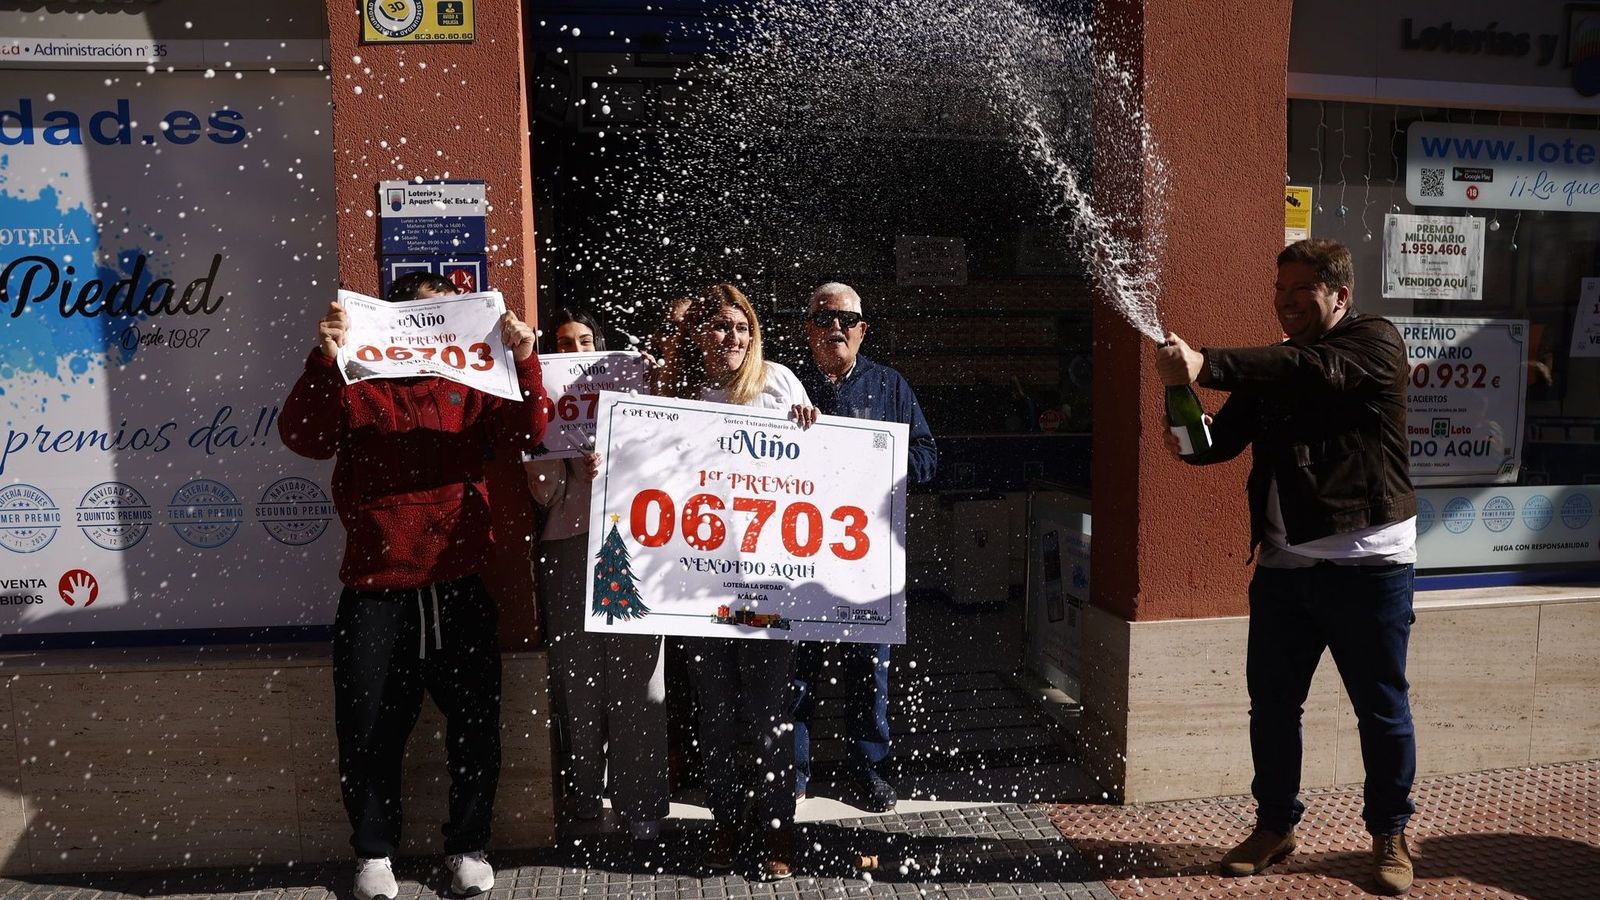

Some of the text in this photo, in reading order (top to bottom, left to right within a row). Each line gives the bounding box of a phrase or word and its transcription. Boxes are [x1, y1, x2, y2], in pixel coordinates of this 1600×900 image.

[388, 1, 405, 13] 3D
[33, 43, 134, 58] Administración
[153, 44, 168, 57] 35
[1536, 34, 1559, 67] y
[0, 98, 247, 146] dad.es
[1421, 134, 1600, 165] www.lote
[1562, 180, 1600, 207] que
[1416, 224, 1454, 234] PREMIO
[1405, 233, 1466, 244] MILLONARIO
[0, 253, 225, 319] Piedad
[1398, 276, 1468, 289] VENDIDO AQUÍ
[405, 312, 445, 328] Niño
[122, 325, 211, 350] Desde 1987
[407, 332, 456, 346] PREMIO
[1404, 327, 1456, 340] PREMIO
[356, 342, 495, 372] 06703
[576, 363, 606, 376] Niño
[1408, 363, 1501, 388] 0.932 €
[574, 382, 615, 394] PREMIO
[1413, 394, 1448, 403] ACIERTOS
[630, 408, 642, 416] DE
[724, 417, 743, 425] Sorteo
[744, 419, 789, 430] Extraordinario
[1408, 426, 1472, 434] Bono Loto
[0, 404, 279, 476] premios da!!
[716, 428, 801, 462] El Niño
[1410, 436, 1493, 457] DO AQUÍ
[698, 469, 814, 496] 1er PREMIO
[88, 486, 124, 504] NAVIDAD
[270, 482, 306, 499] NAVIDAD
[24, 490, 48, 507] JUEVES
[25, 512, 60, 523] PREMIO
[76, 510, 152, 522] 2 QUINTOS PREMIOS
[168, 508, 243, 519] TERCER PREMIO
[256, 506, 298, 516] SEGUNDO
[629, 488, 870, 561] 06703
[1493, 544, 1513, 552] JUEGA
[1532, 542, 1590, 550] RESPONSABILIDAD
[680, 556, 816, 581] VENDIDO AQUÍ
[0, 578, 47, 589] VENTA
[723, 581, 750, 590] LOTERÍA
[0, 594, 44, 605] BIDOS
[738, 592, 768, 601] MÁLAGA
